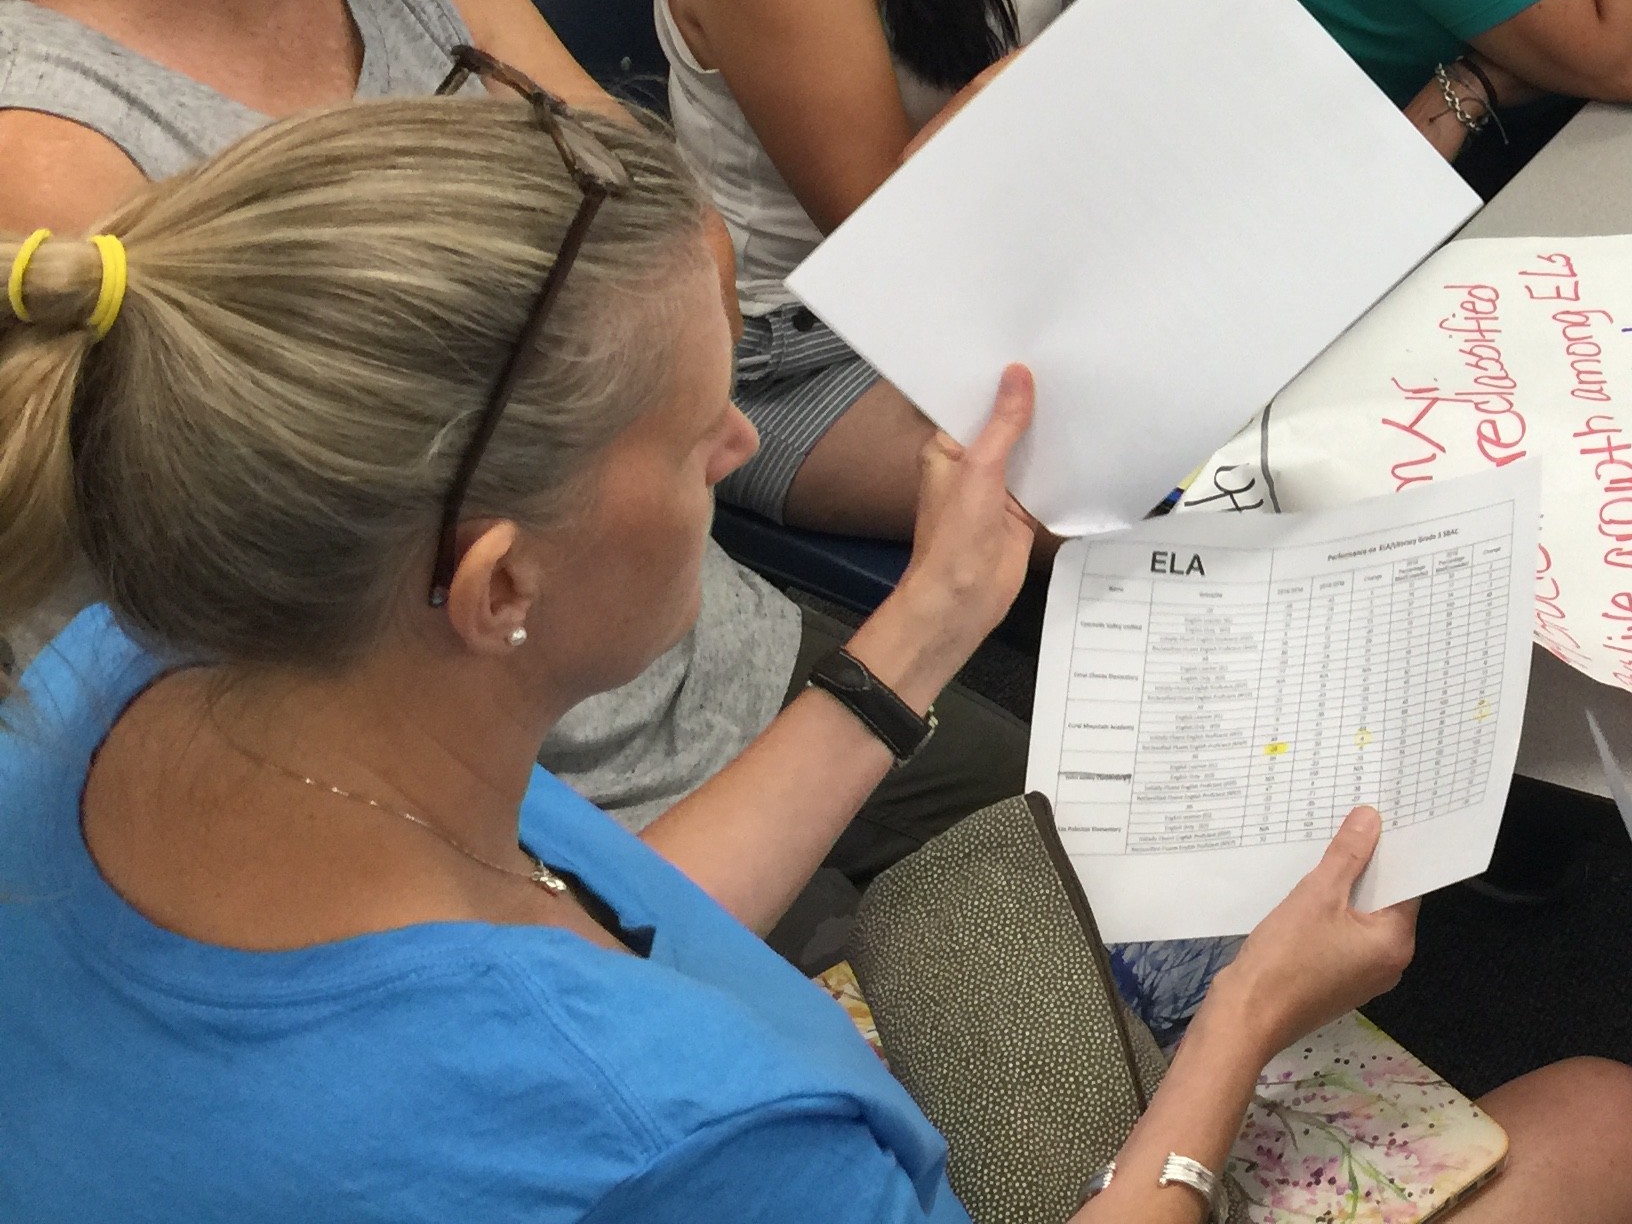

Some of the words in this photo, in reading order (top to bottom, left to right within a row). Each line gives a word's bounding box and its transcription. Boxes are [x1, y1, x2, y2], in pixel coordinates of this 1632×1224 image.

[1440, 283, 1528, 467] reclassified
[1552, 307, 1614, 402] among
[1150, 551, 1205, 576] ELA
